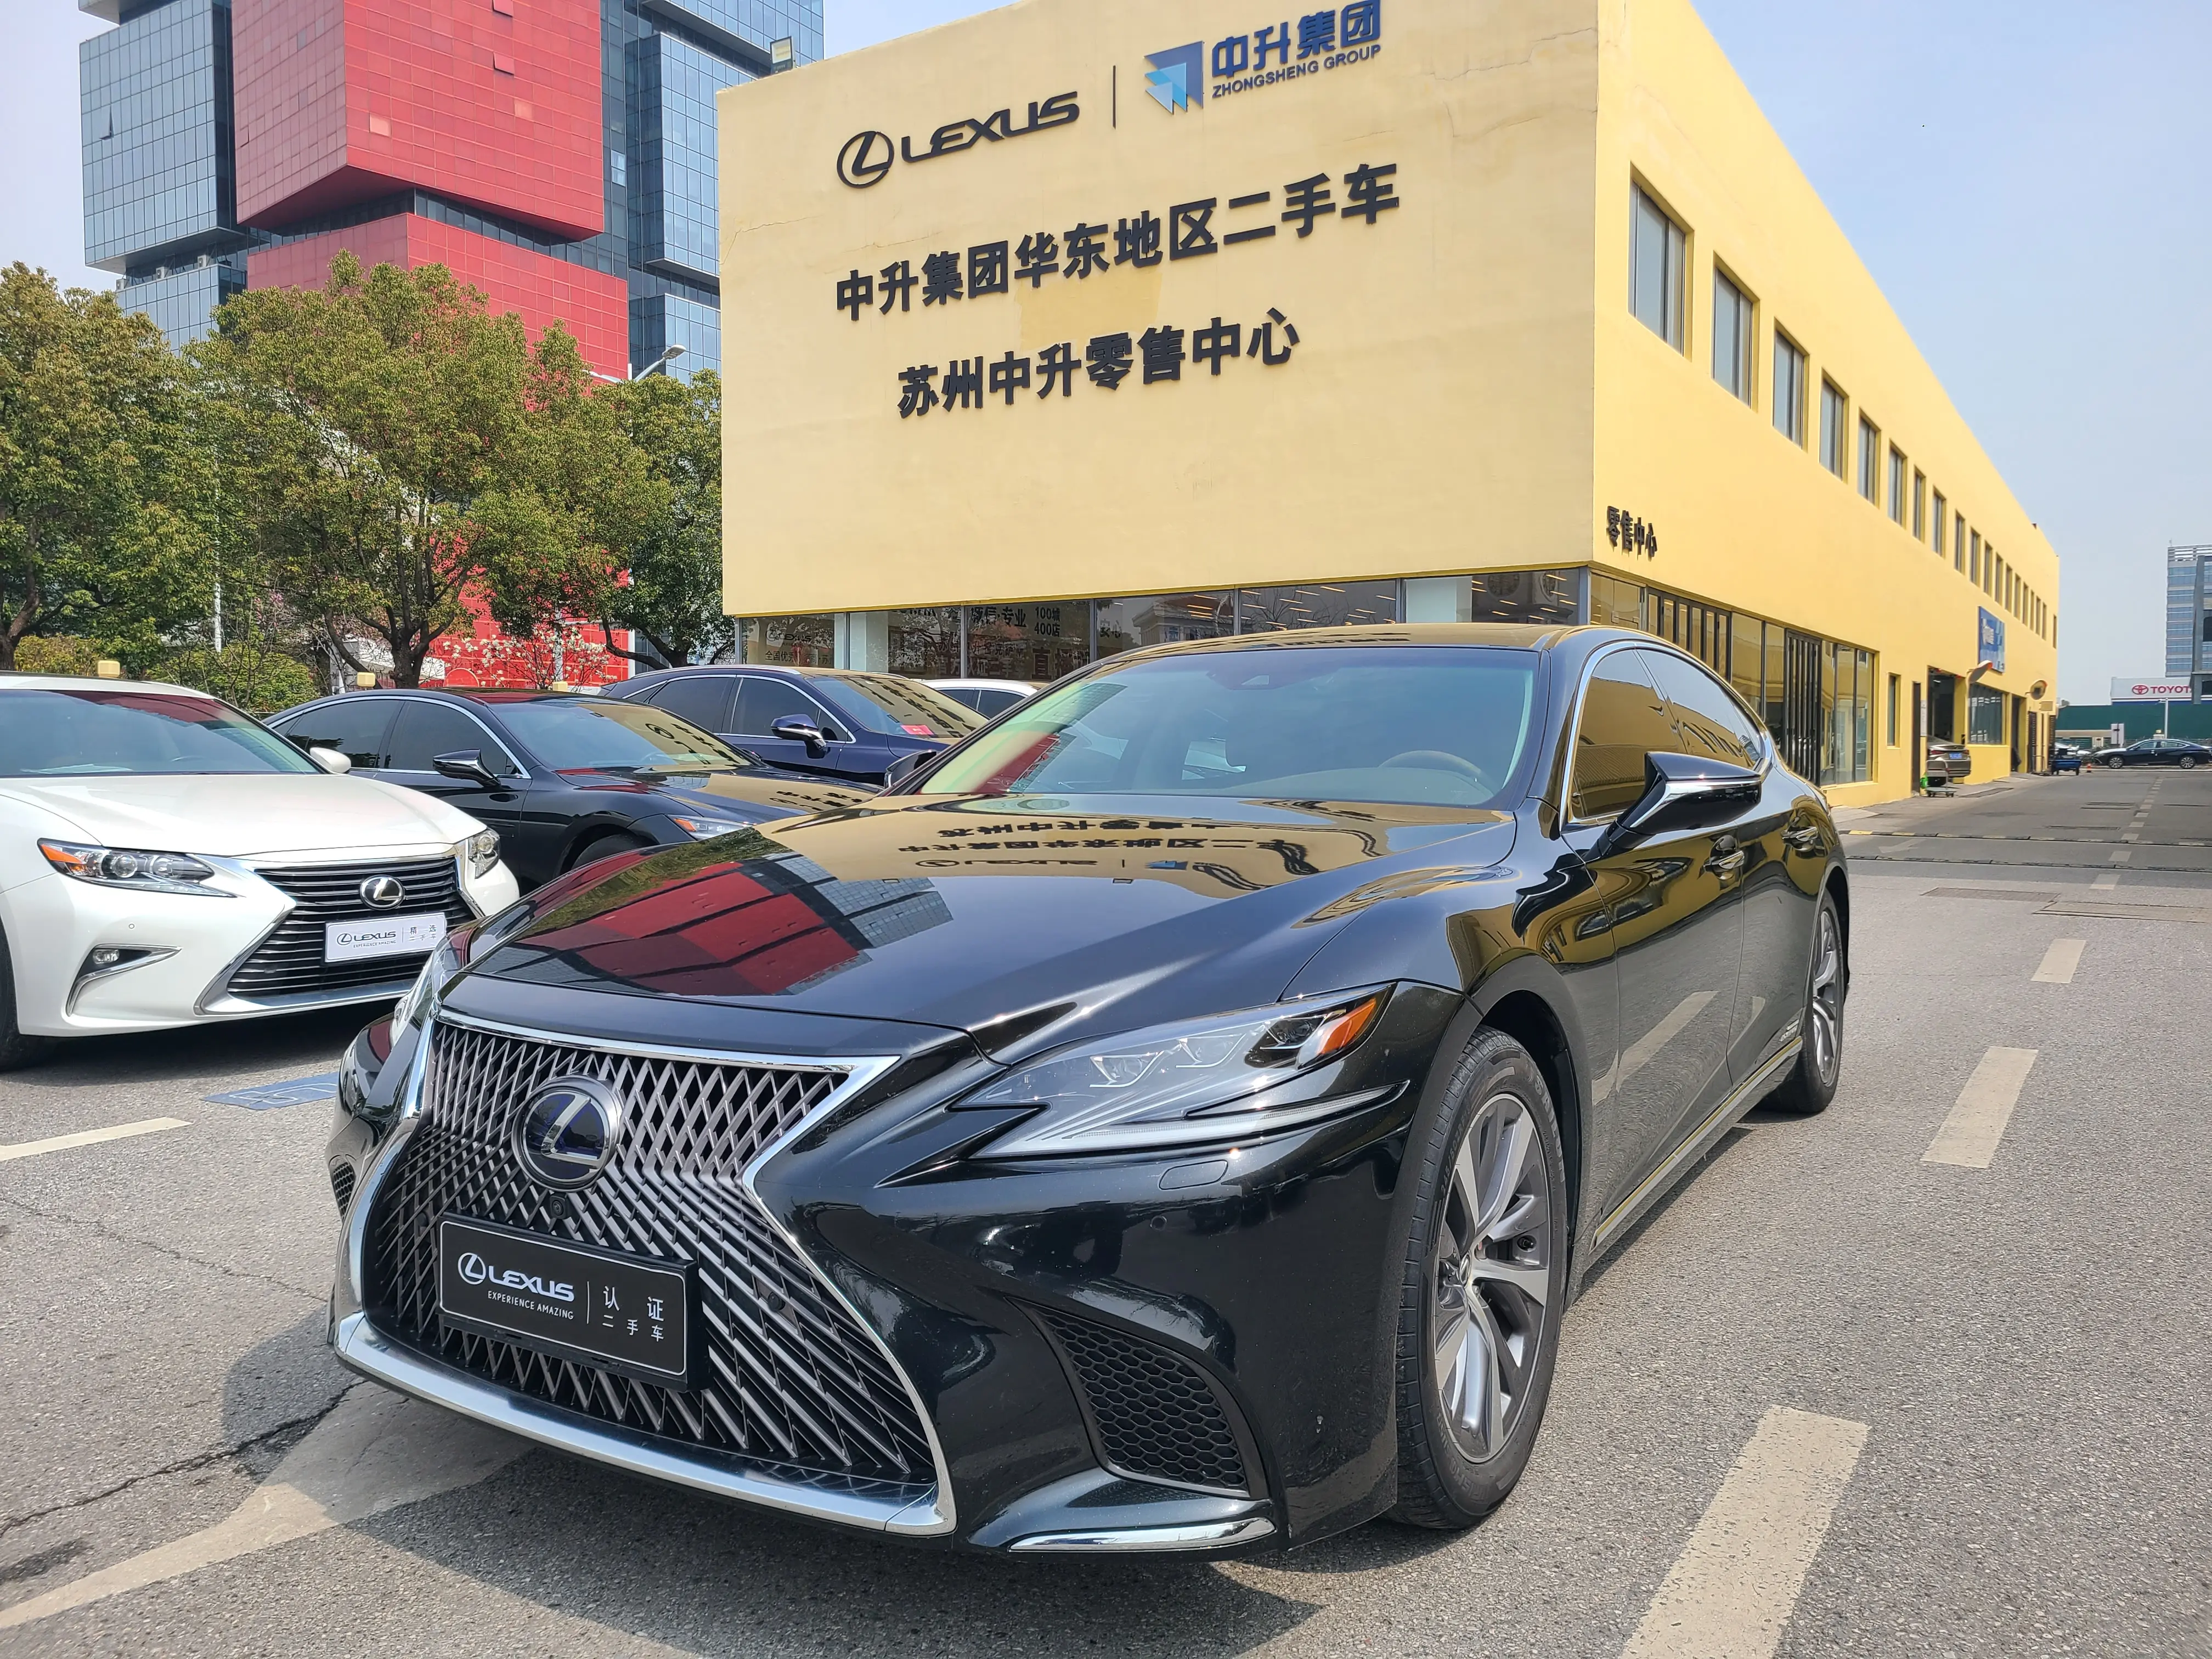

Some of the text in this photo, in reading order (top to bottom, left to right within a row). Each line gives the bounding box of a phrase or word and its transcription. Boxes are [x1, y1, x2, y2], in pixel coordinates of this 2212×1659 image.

[1212, 0, 1381, 78] 中升集团
[1212, 44, 1381, 99] ZHONGSHENG GROUP
[901, 91, 1080, 163] LEXUS
[837, 163, 1400, 321] 中升集团华东地区二手车
[898, 307, 1300, 419] 苏州中升零售中心
[1606, 505, 1658, 558] 零售中心
[2151, 686, 2192, 694] TOYOT
[354, 931, 396, 942] LEXUS
[488, 1265, 575, 1302] LEXUS
[488, 1290, 574, 1320] EXPERIENCE AMAZING
[603, 1286, 664, 1322] 认证
[602, 1314, 664, 1342] 二手车
